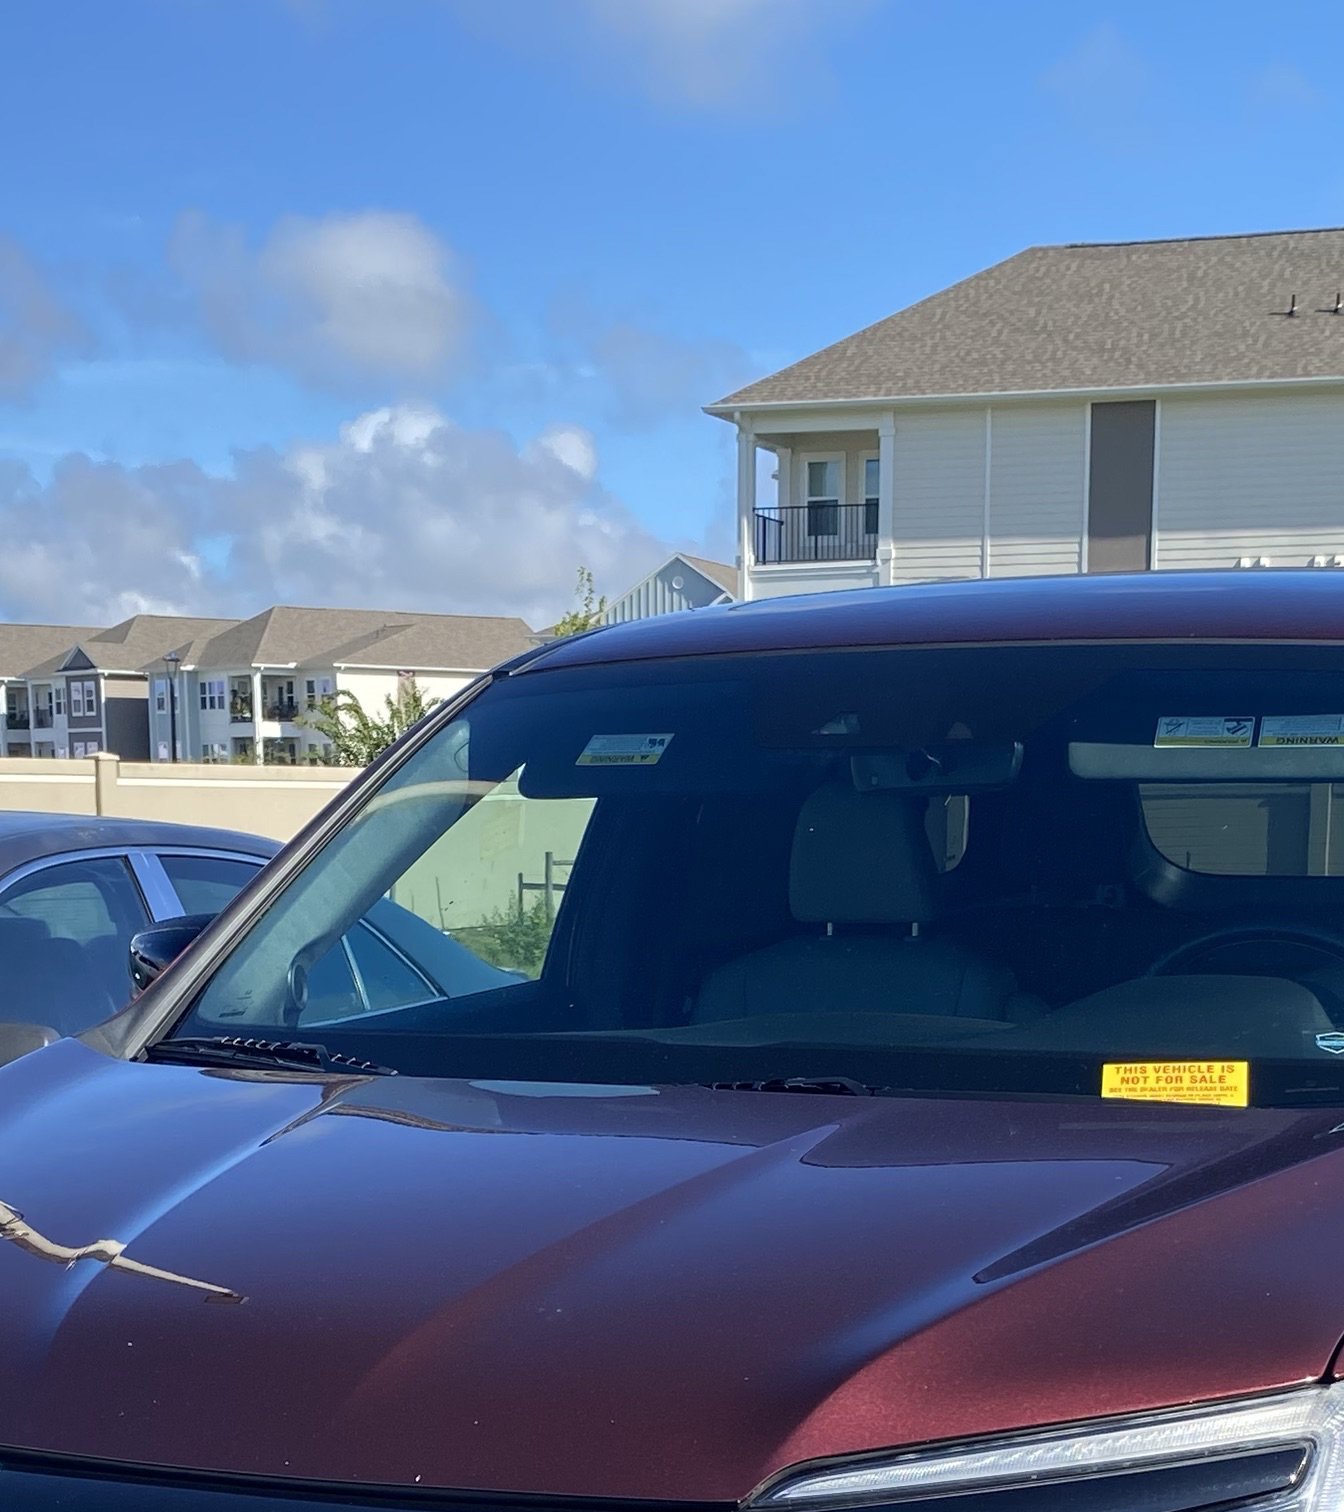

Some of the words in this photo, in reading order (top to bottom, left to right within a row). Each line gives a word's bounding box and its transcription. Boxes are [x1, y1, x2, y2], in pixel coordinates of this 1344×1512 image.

[1275, 736, 1339, 745] WARNING
[1114, 1066, 1147, 1074] THIS
[1153, 1065, 1214, 1074] VEHICLE
[1221, 1064, 1235, 1073] IS
[1120, 1076, 1150, 1085] NOT
[1155, 1075, 1183, 1084] FOR
[1190, 1075, 1227, 1084] SALE
